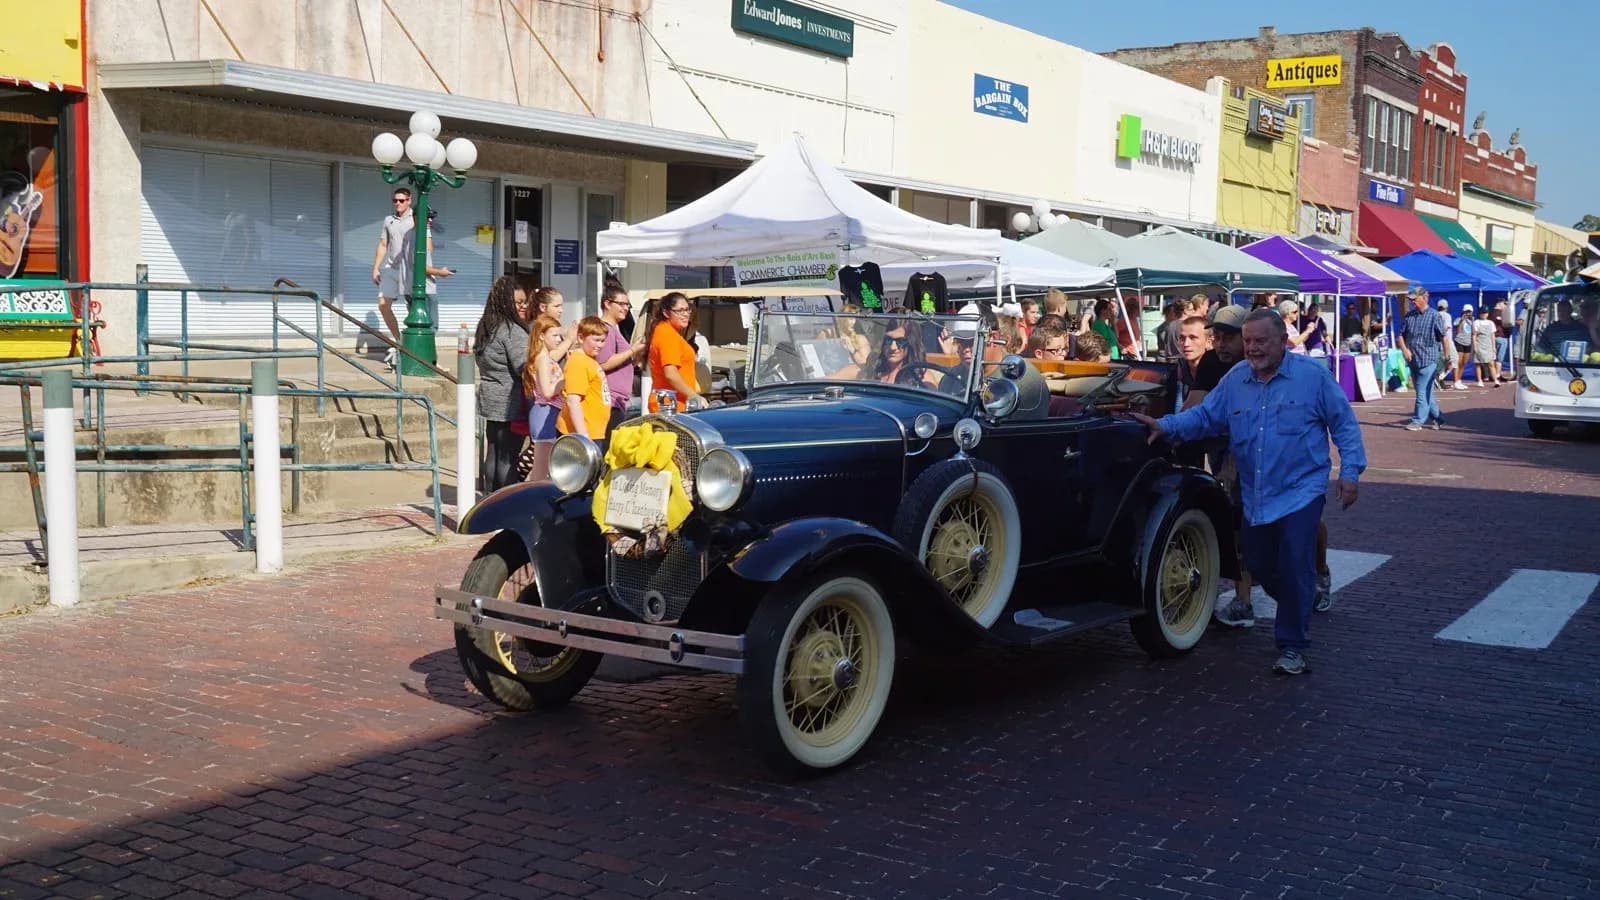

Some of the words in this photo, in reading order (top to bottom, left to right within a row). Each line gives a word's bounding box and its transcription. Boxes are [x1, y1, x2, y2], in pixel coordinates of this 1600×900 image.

[807, 21, 851, 43] INVESTMENTS
[1274, 61, 1338, 83] Antiques
[994, 80, 1012, 93] THE
[975, 92, 1012, 108] BARGAIN
[1012, 96, 1028, 118] BOX
[1145, 129, 1169, 156] H&R
[513, 190, 531, 198] 1227
[737, 257, 765, 266] Welcome
[766, 255, 773, 263] To
[774, 254, 785, 262] The
[820, 251, 836, 260] Bash
[739, 266, 785, 280] COMMERCE
[787, 263, 826, 276] CHAMBER
[769, 301, 813, 312] Chvrolet
